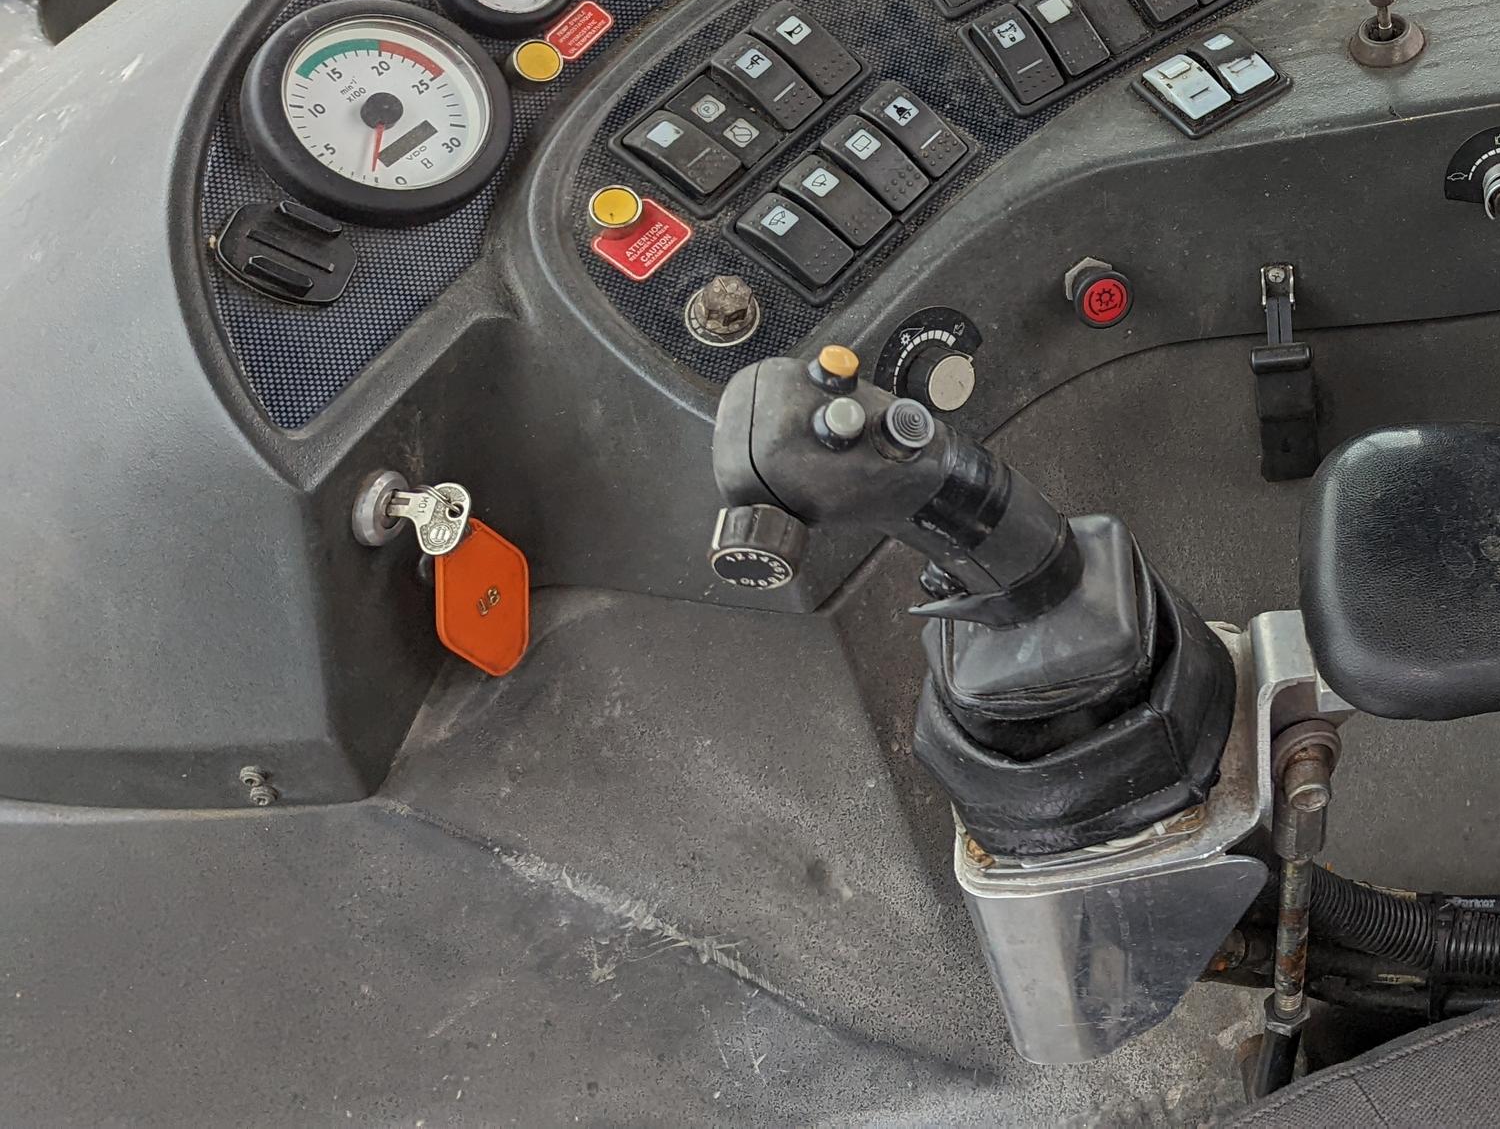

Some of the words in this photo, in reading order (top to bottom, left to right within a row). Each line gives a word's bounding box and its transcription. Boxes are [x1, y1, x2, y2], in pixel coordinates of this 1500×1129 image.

[326, 67, 343, 82] 15
[371, 60, 391, 77] 20
[411, 79, 430, 96] 25
[308, 103, 326, 118] 10
[324, 143, 337, 156] 5
[406, 145, 427, 160] VDO
[441, 136, 462, 154] 30
[394, 176, 408, 186] 0
[625, 221, 664, 258] ATTENTION
[640, 234, 672, 263] CAUTION
